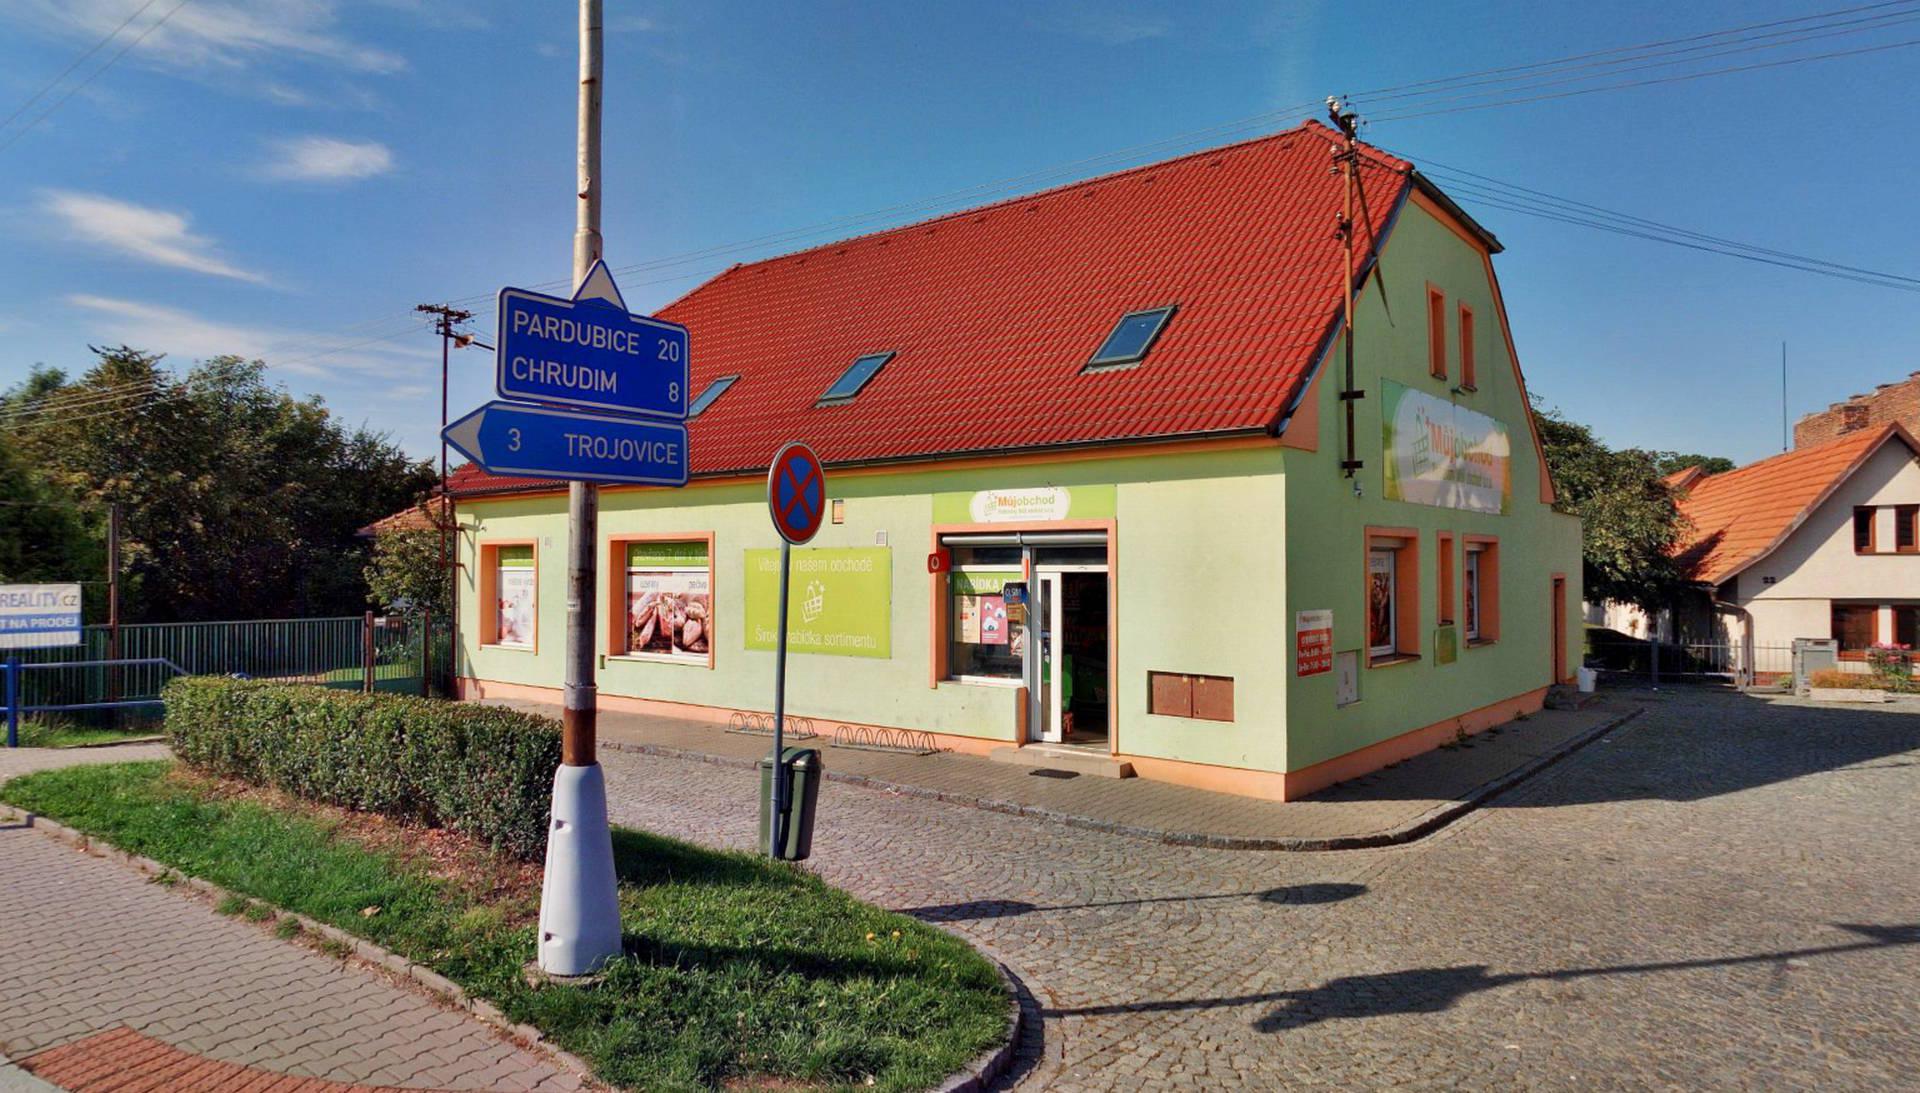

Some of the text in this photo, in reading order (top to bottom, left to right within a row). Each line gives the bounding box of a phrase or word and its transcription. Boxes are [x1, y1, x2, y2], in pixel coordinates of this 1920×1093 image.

[513, 310, 680, 363] PARDUBICE 20
[512, 356, 679, 402] CHRUDIM 8
[508, 428, 679, 464] 3 TROJOVICE
[31, 616, 77, 628] PRODEJ
[755, 624, 778, 643] Širok
